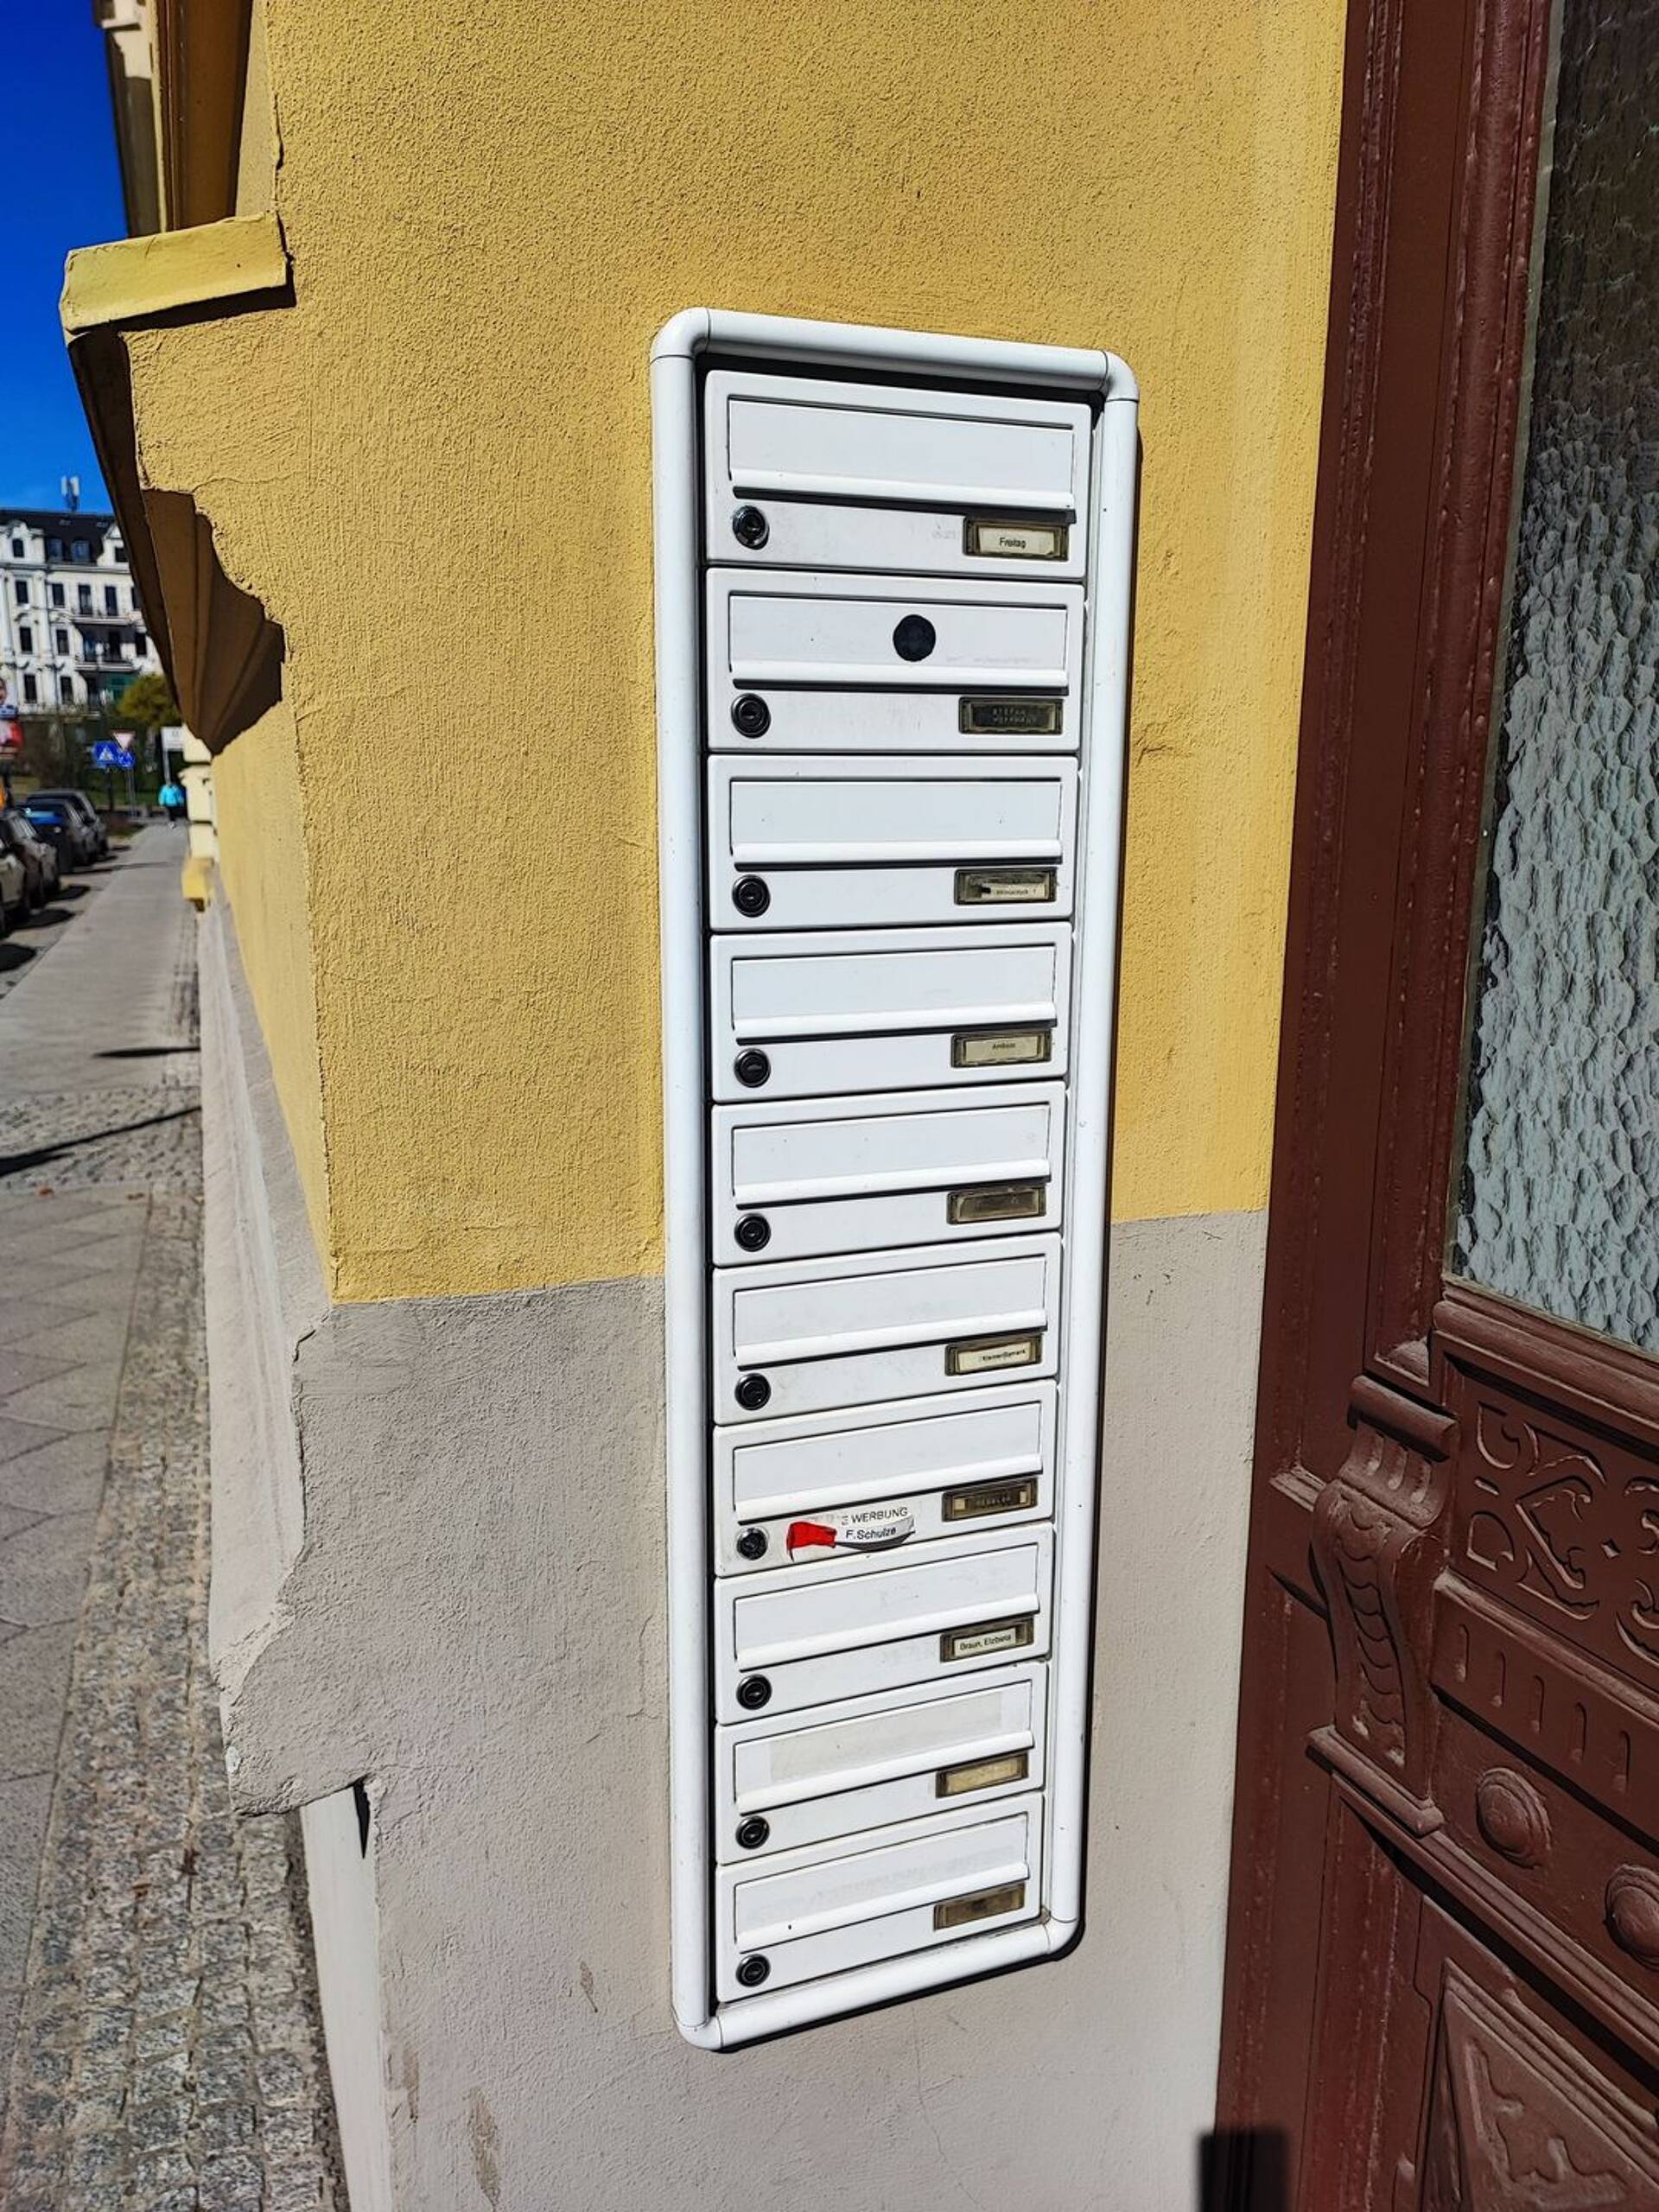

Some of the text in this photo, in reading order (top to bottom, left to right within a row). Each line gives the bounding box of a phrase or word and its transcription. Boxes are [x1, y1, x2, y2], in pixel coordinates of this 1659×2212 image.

[999, 537, 1027, 550] Freitag
[851, 1506, 907, 1523] WERBUNG
[845, 1526, 896, 1540] F.Schulze
